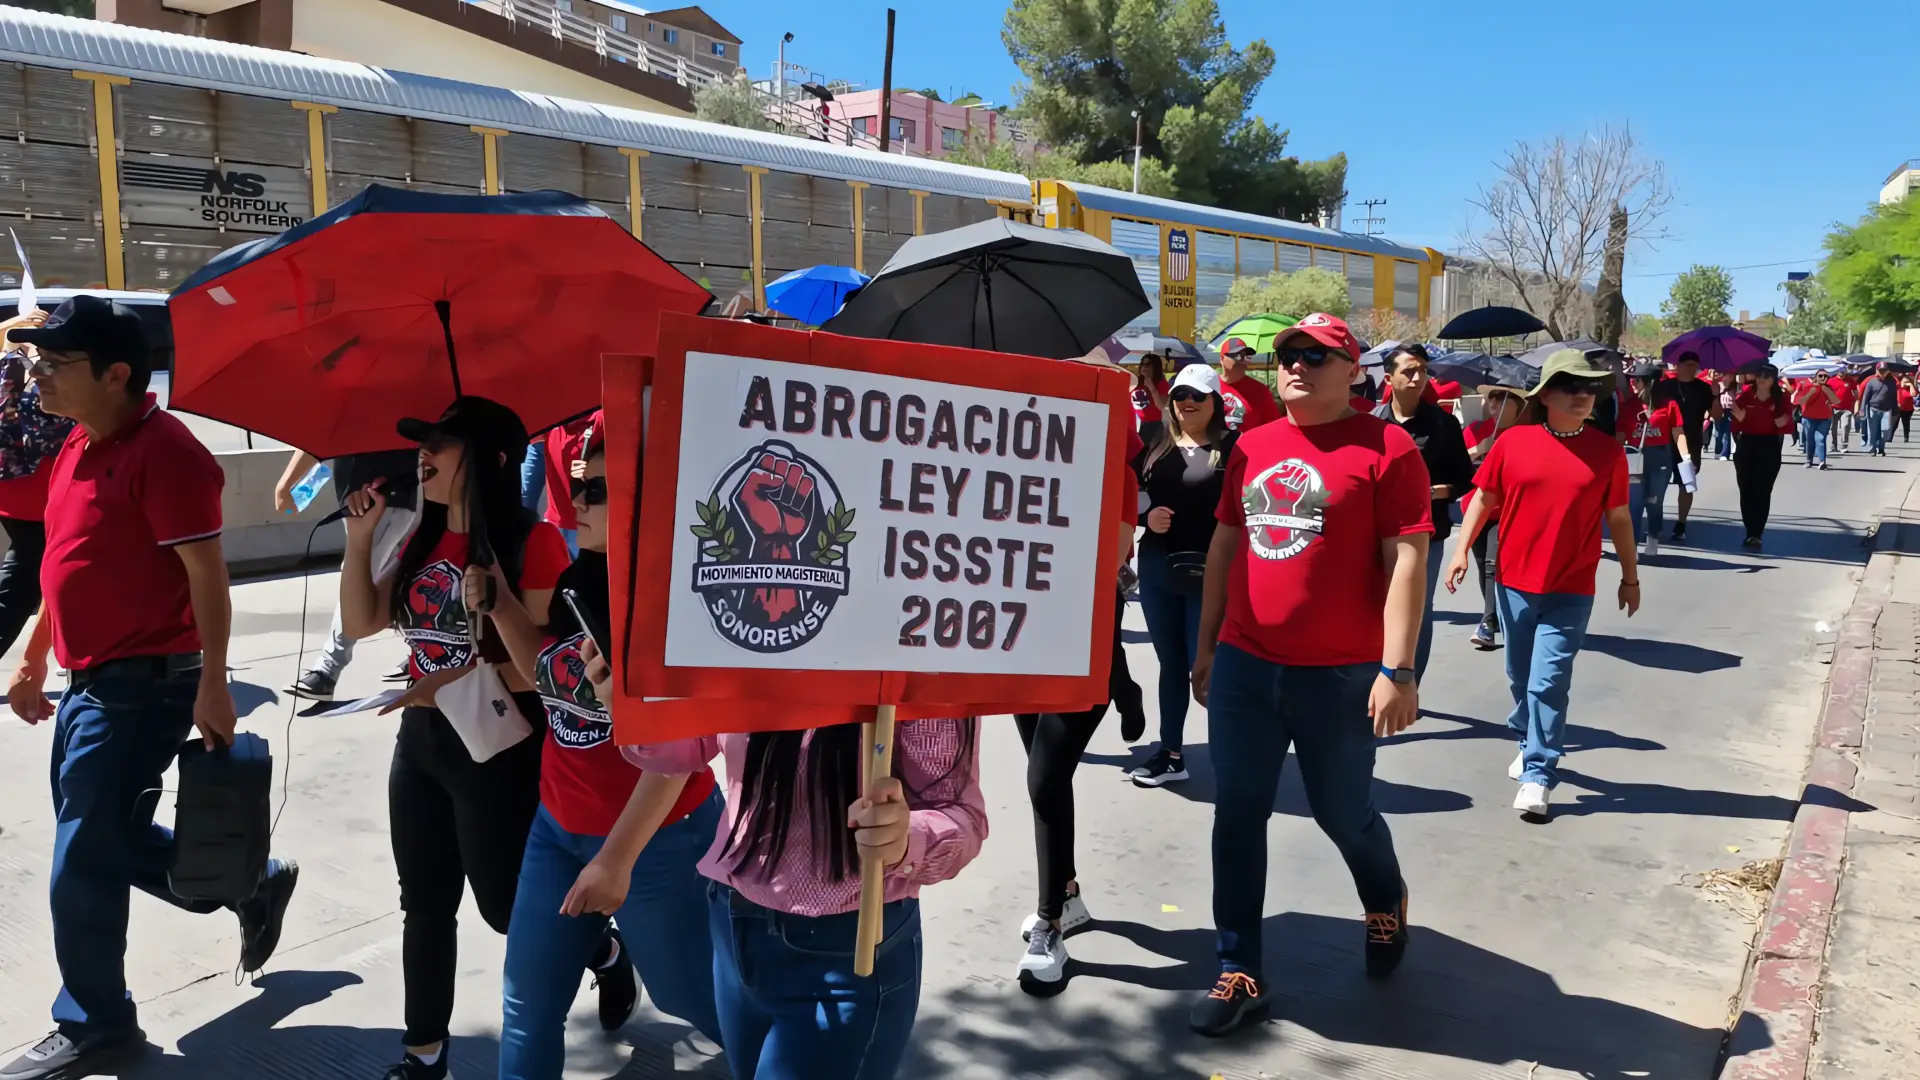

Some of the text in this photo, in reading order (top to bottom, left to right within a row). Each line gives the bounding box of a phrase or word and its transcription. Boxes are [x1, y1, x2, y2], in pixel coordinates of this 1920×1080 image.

[201, 169, 267, 198] NS
[201, 195, 288, 214] NORFOLK
[202, 210, 303, 228] SOUTHERN
[738, 375, 1076, 464] ABROGACIÓN
[879, 458, 1070, 528] LEY DEL
[701, 566, 842, 585] MOVIMIENTO MAGISTERIAL
[884, 526, 1054, 591] ISSSTE
[711, 598, 828, 646] SONORENSE
[898, 595, 1027, 651] 2007
